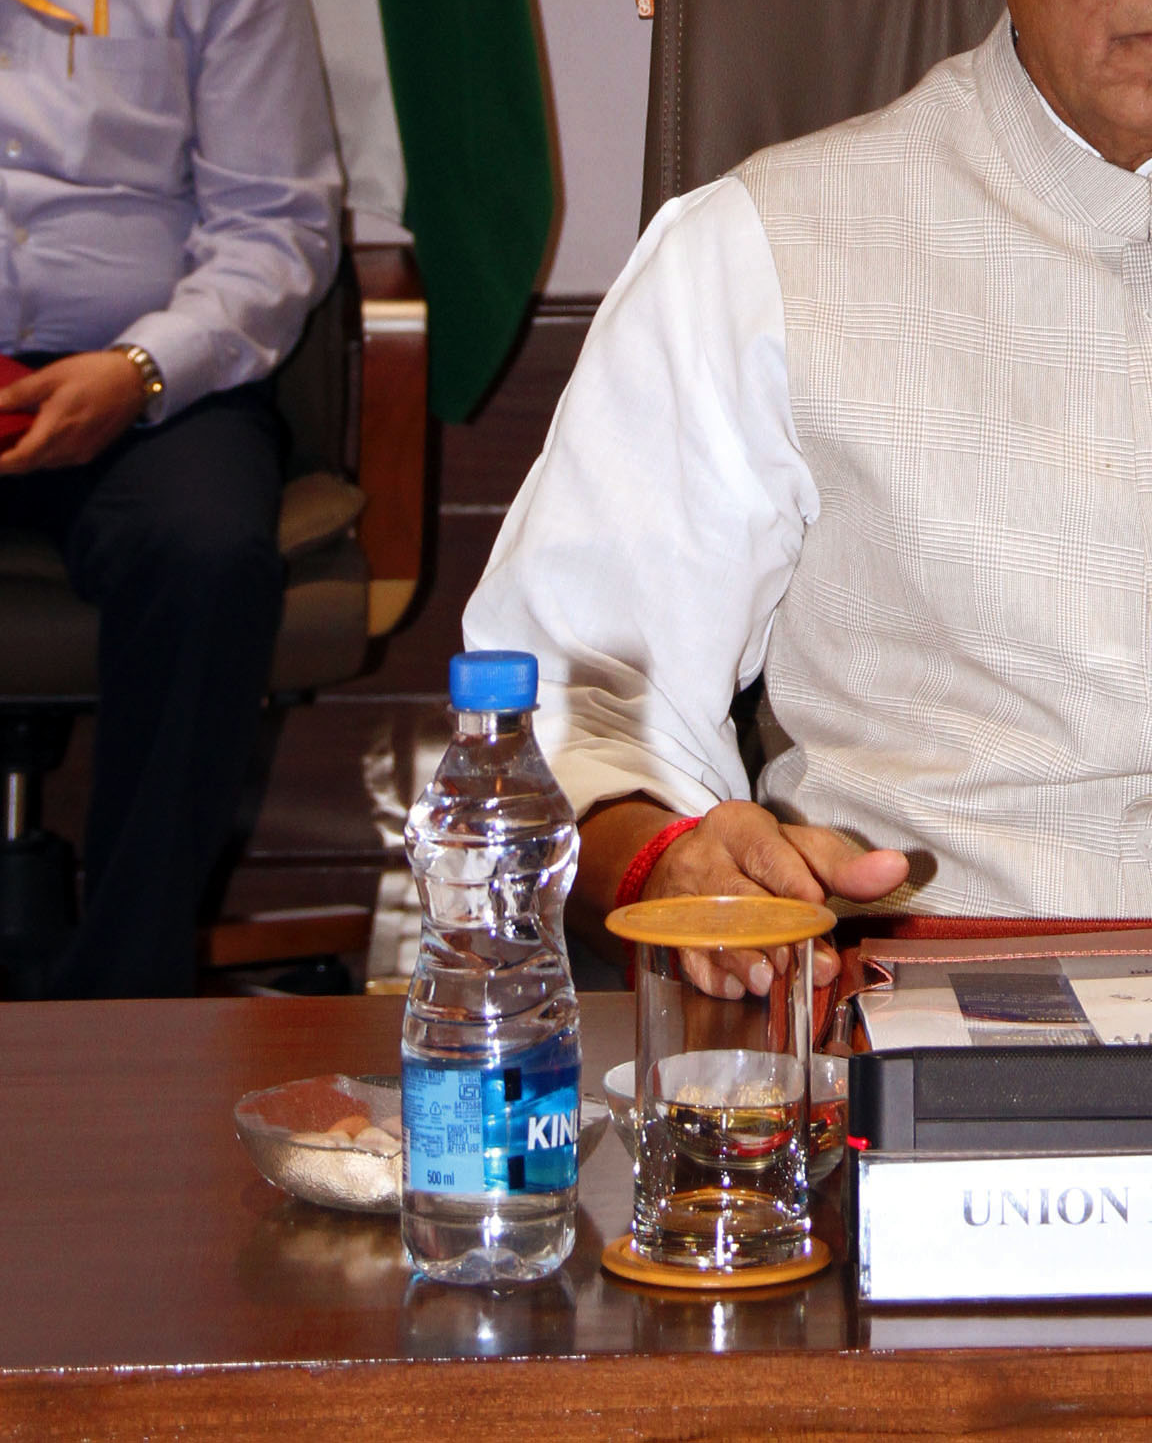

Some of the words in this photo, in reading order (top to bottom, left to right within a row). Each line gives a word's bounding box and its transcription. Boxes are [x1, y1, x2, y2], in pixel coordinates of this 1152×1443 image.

[427, 1169, 442, 1185] 500
[443, 1171, 455, 1186] ml
[961, 1186, 1130, 1226] UNION
